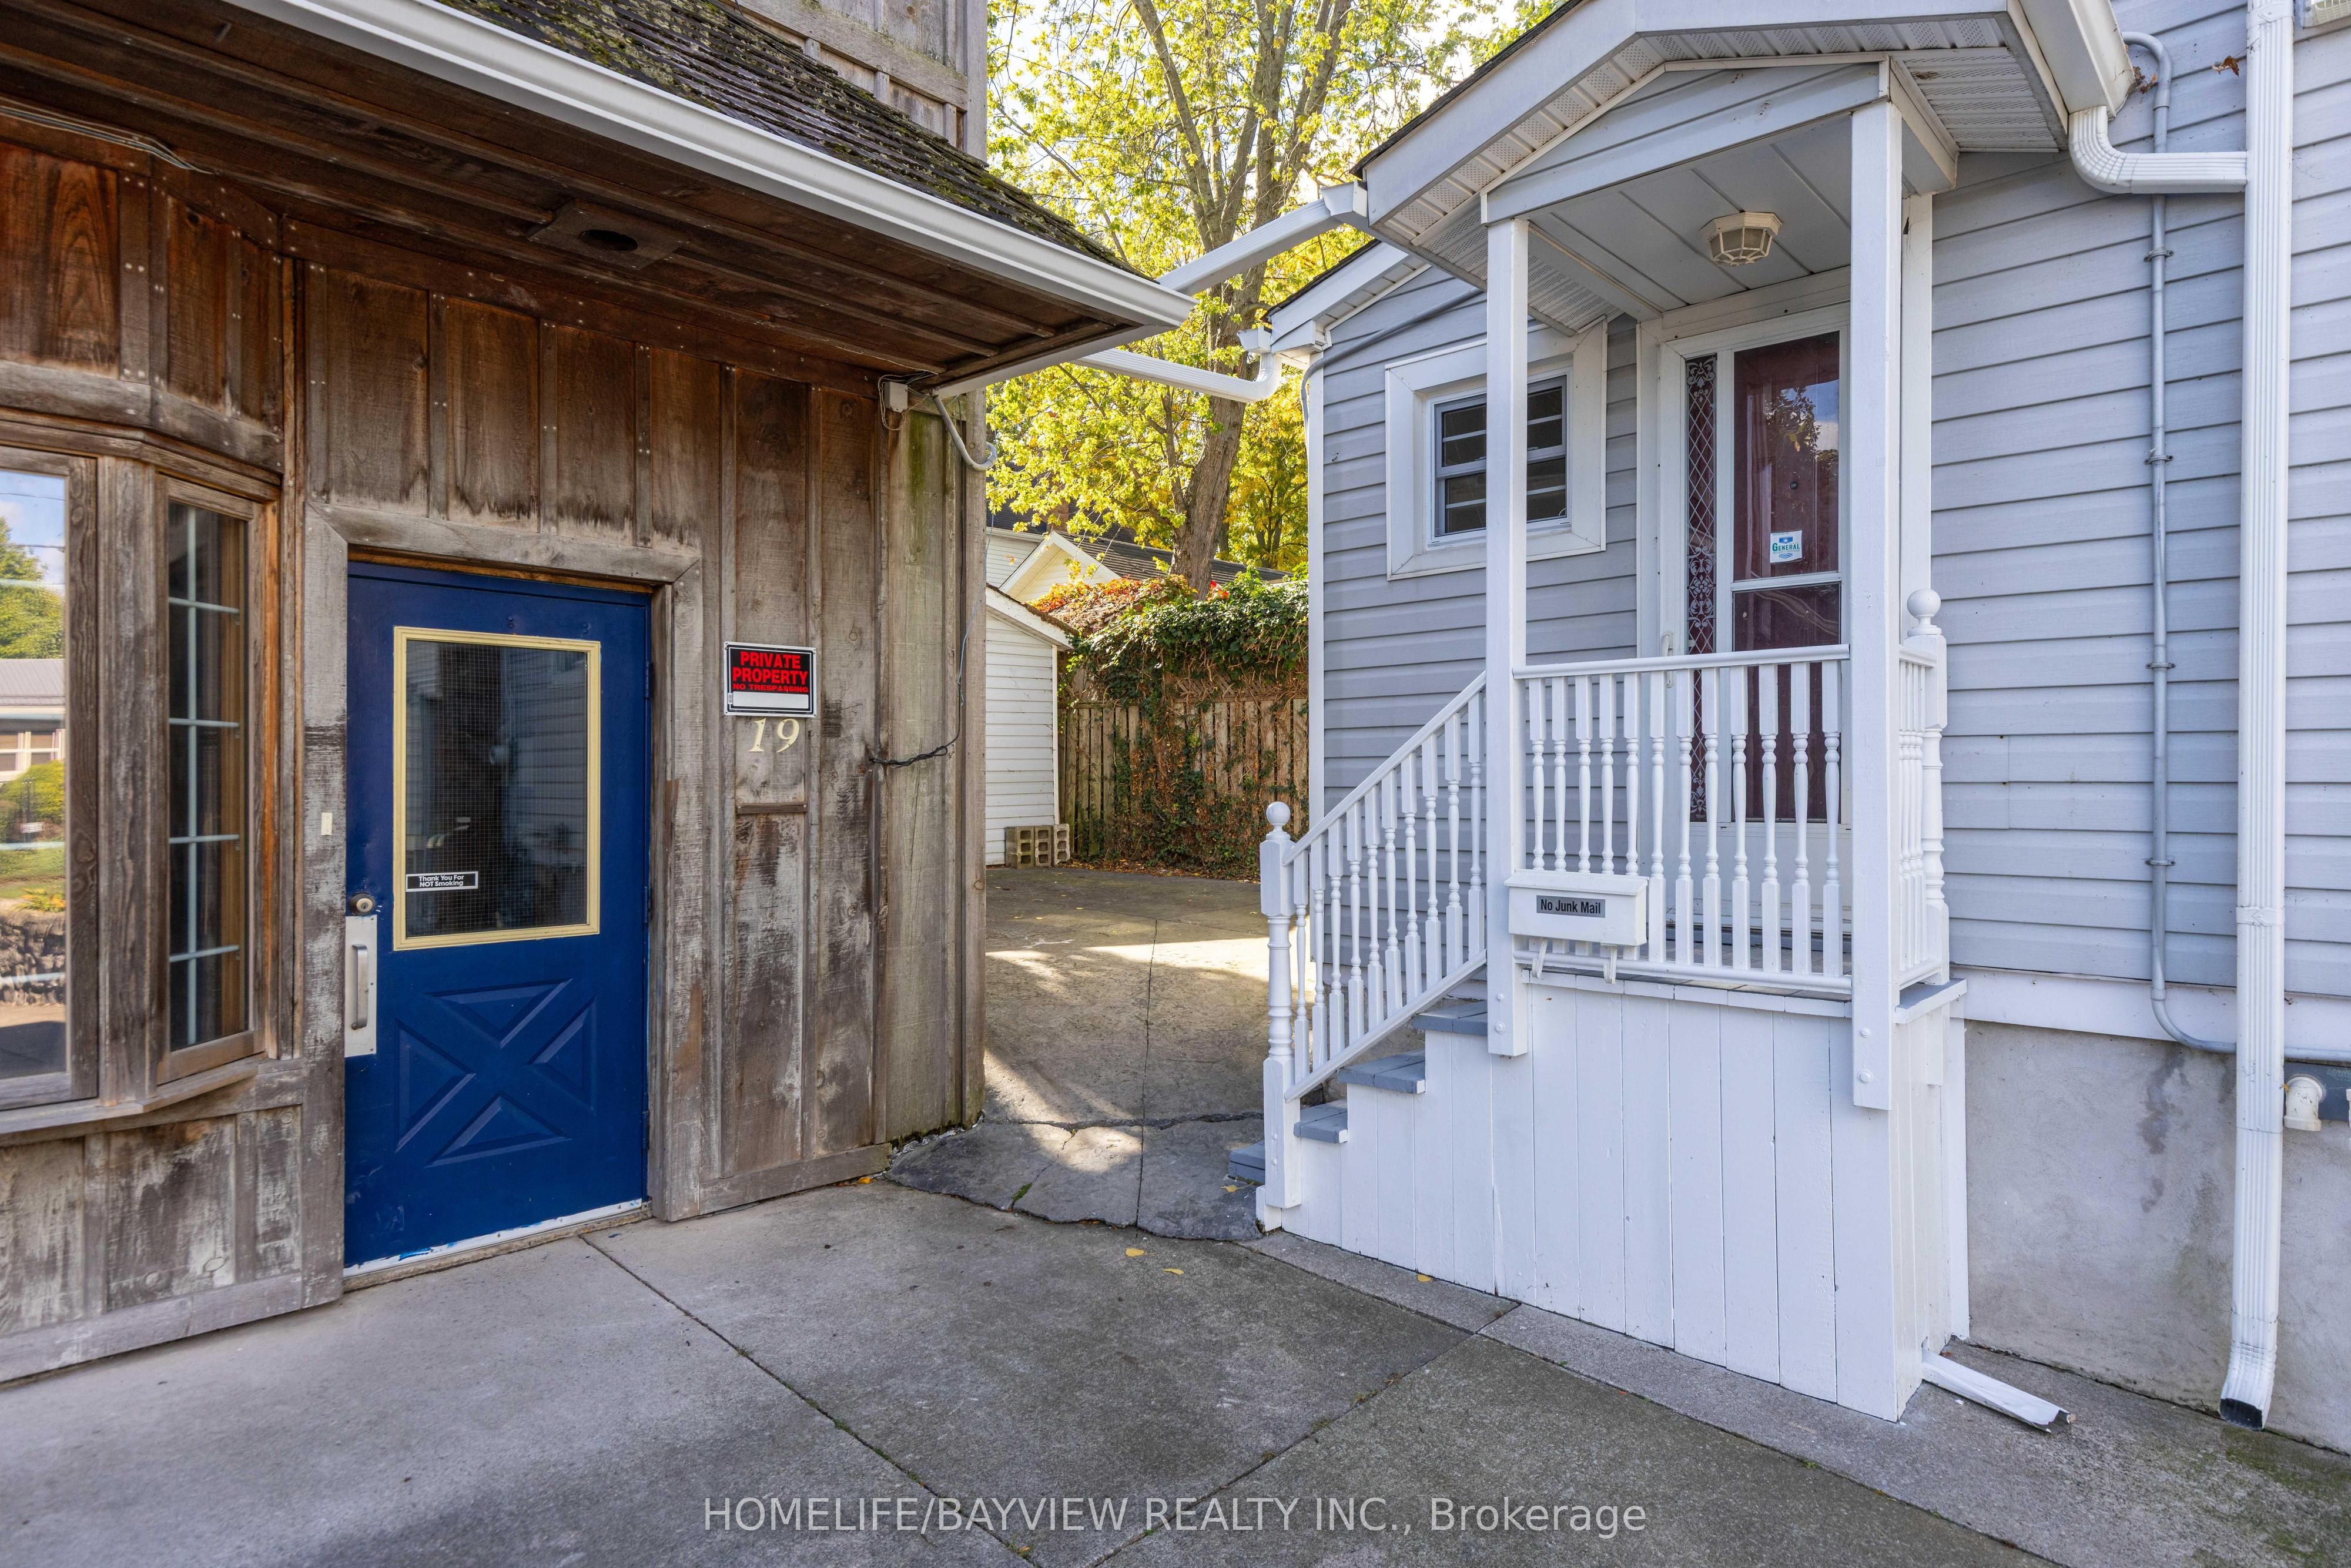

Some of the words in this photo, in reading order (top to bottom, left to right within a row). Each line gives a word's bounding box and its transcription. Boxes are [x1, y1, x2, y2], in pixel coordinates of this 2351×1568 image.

[1772, 542, 1800, 551] GENERAL
[740, 651, 801, 669] PRIVATE
[732, 667, 808, 685] PROPERTY
[748, 684, 809, 692] TRESPASSING
[748, 718, 799, 753] 19
[1540, 899, 1553, 911] No
[1555, 900, 1578, 912] Junk
[1580, 901, 1601, 914] Mail
